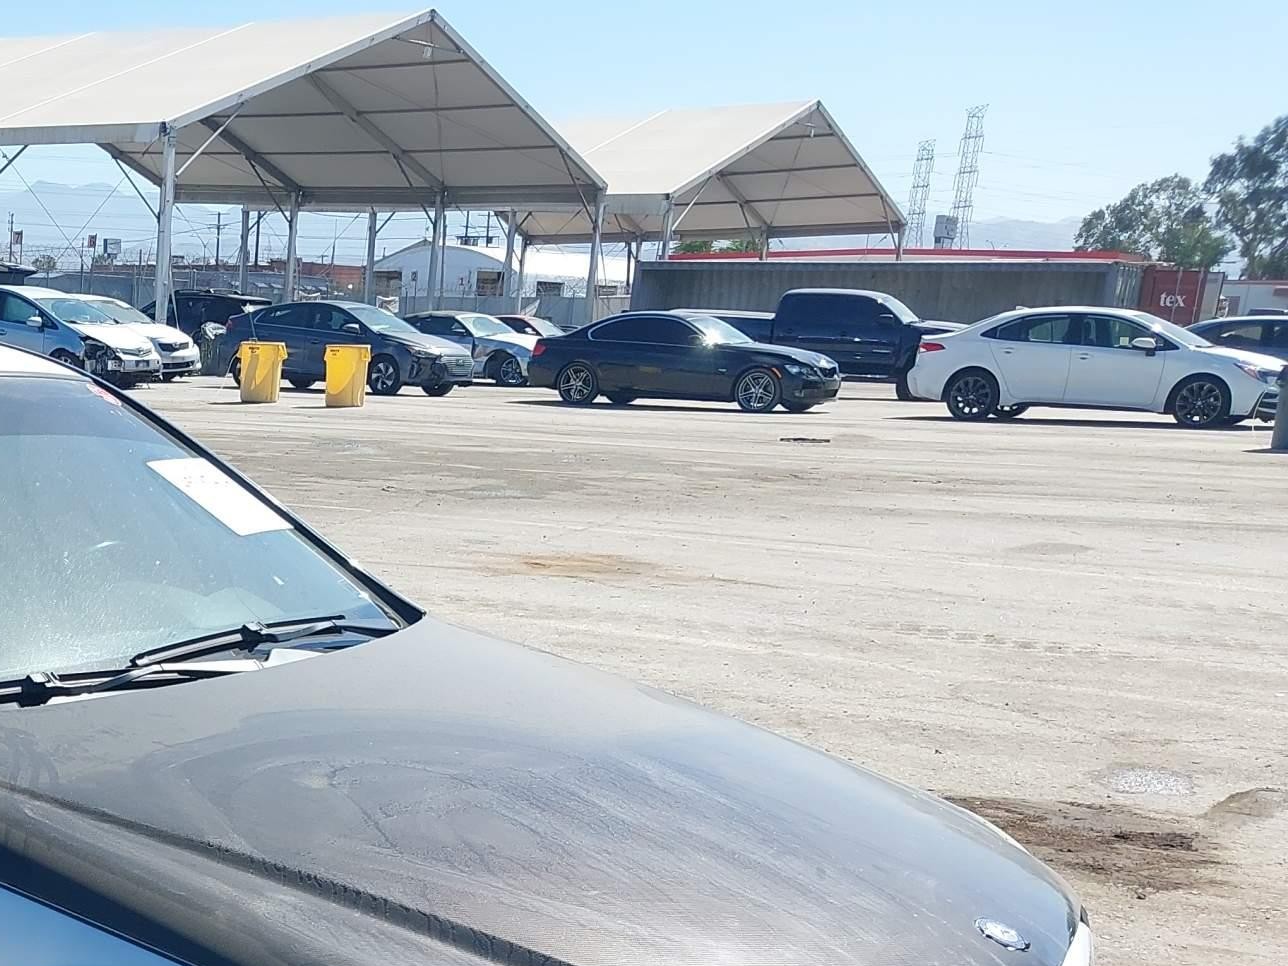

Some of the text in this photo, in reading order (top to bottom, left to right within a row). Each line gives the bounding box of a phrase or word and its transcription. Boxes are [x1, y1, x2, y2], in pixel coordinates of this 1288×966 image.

[14, 232, 21, 244] 7
[411, 271, 417, 282] 2
[1159, 291, 1187, 308] tex
